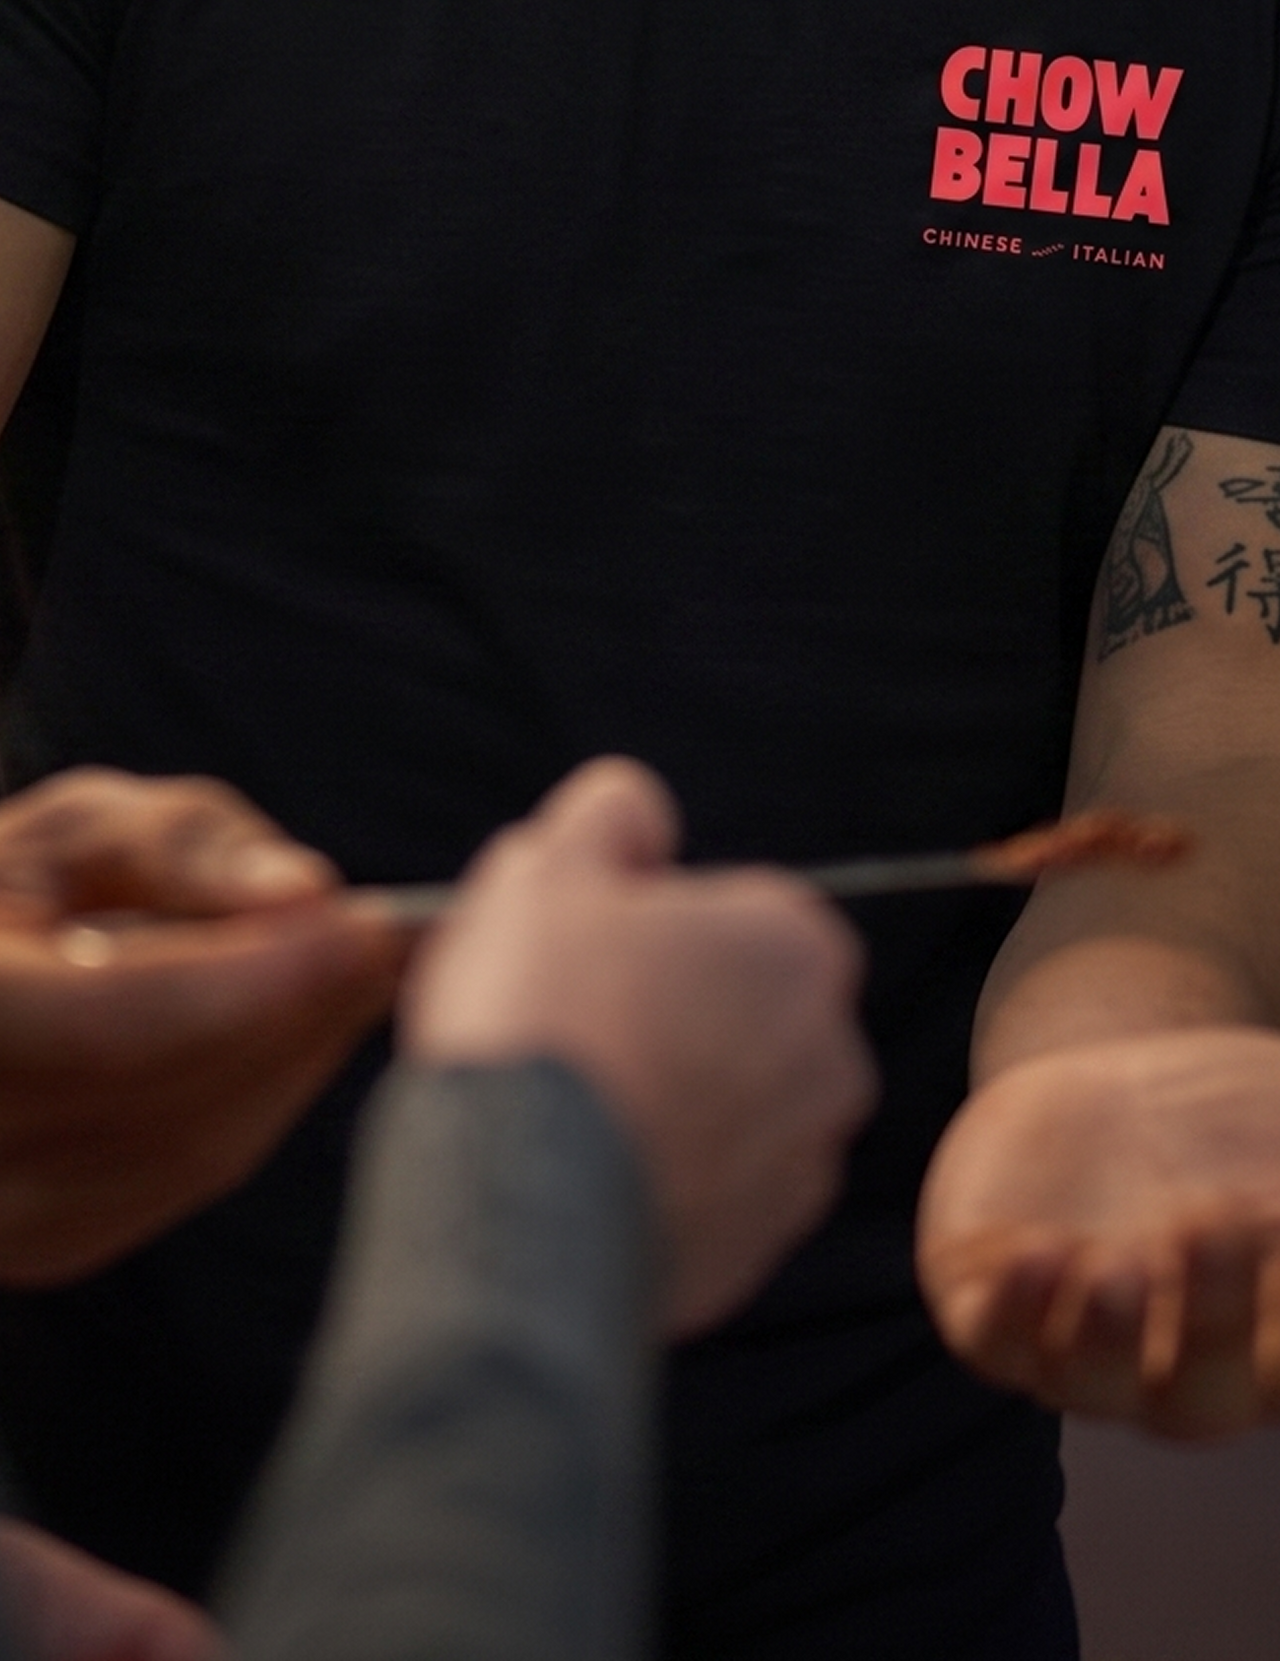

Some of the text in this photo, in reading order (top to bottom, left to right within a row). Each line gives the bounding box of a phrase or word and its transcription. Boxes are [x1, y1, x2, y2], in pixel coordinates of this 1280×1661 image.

[940, 45, 1184, 140] CHOW
[929, 126, 1170, 226] BELLA
[922, 228, 1022, 255] CHINESE
[1072, 244, 1165, 270] ITALIAN
